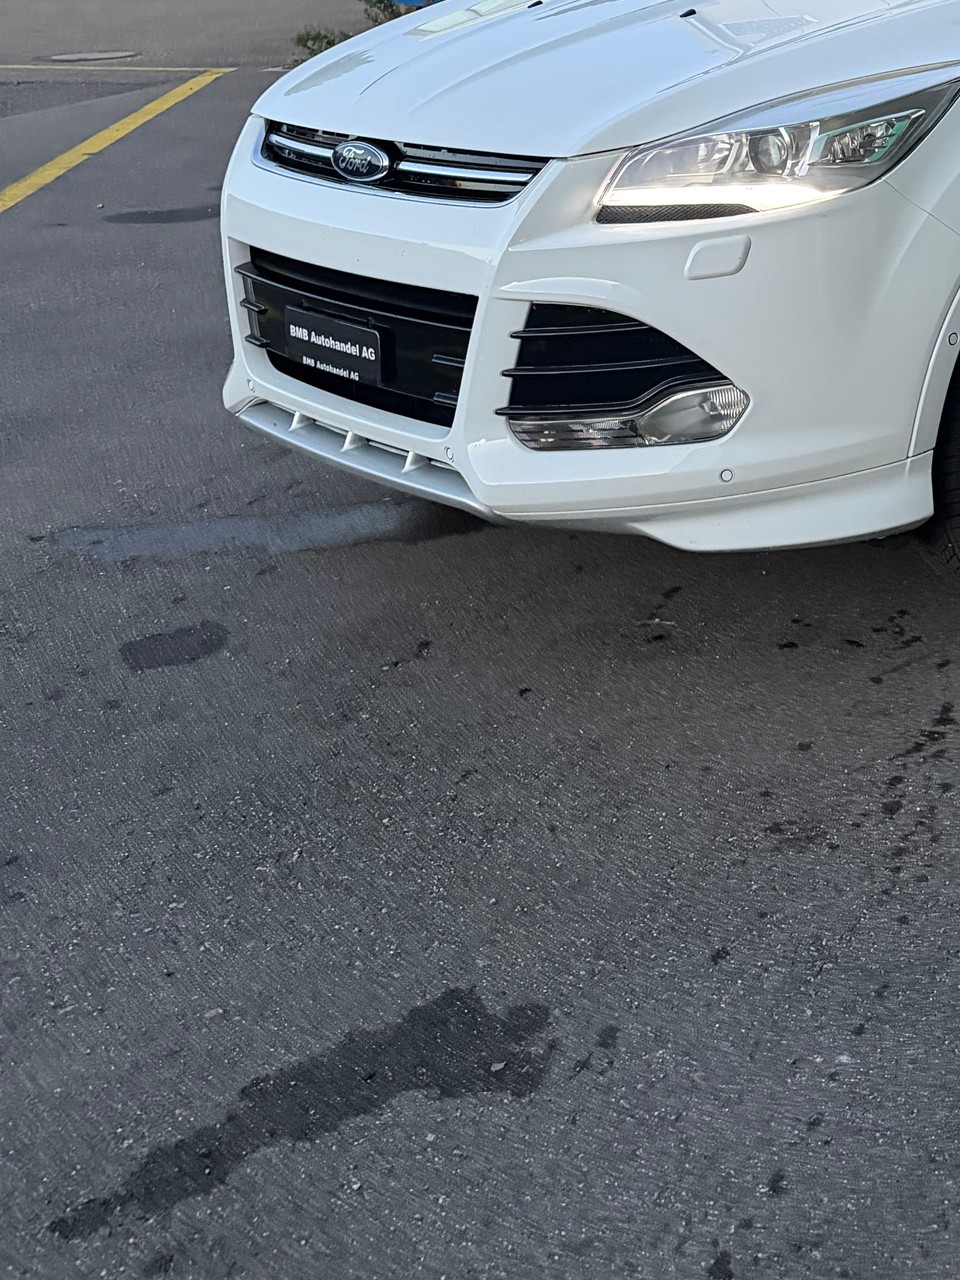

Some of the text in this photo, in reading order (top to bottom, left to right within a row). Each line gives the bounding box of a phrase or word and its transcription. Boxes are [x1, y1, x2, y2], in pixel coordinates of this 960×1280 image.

[339, 146, 371, 173] Ford
[290, 324, 376, 361] BMB Autohandel AG
[302, 355, 360, 381] BMB Autohandel AG
